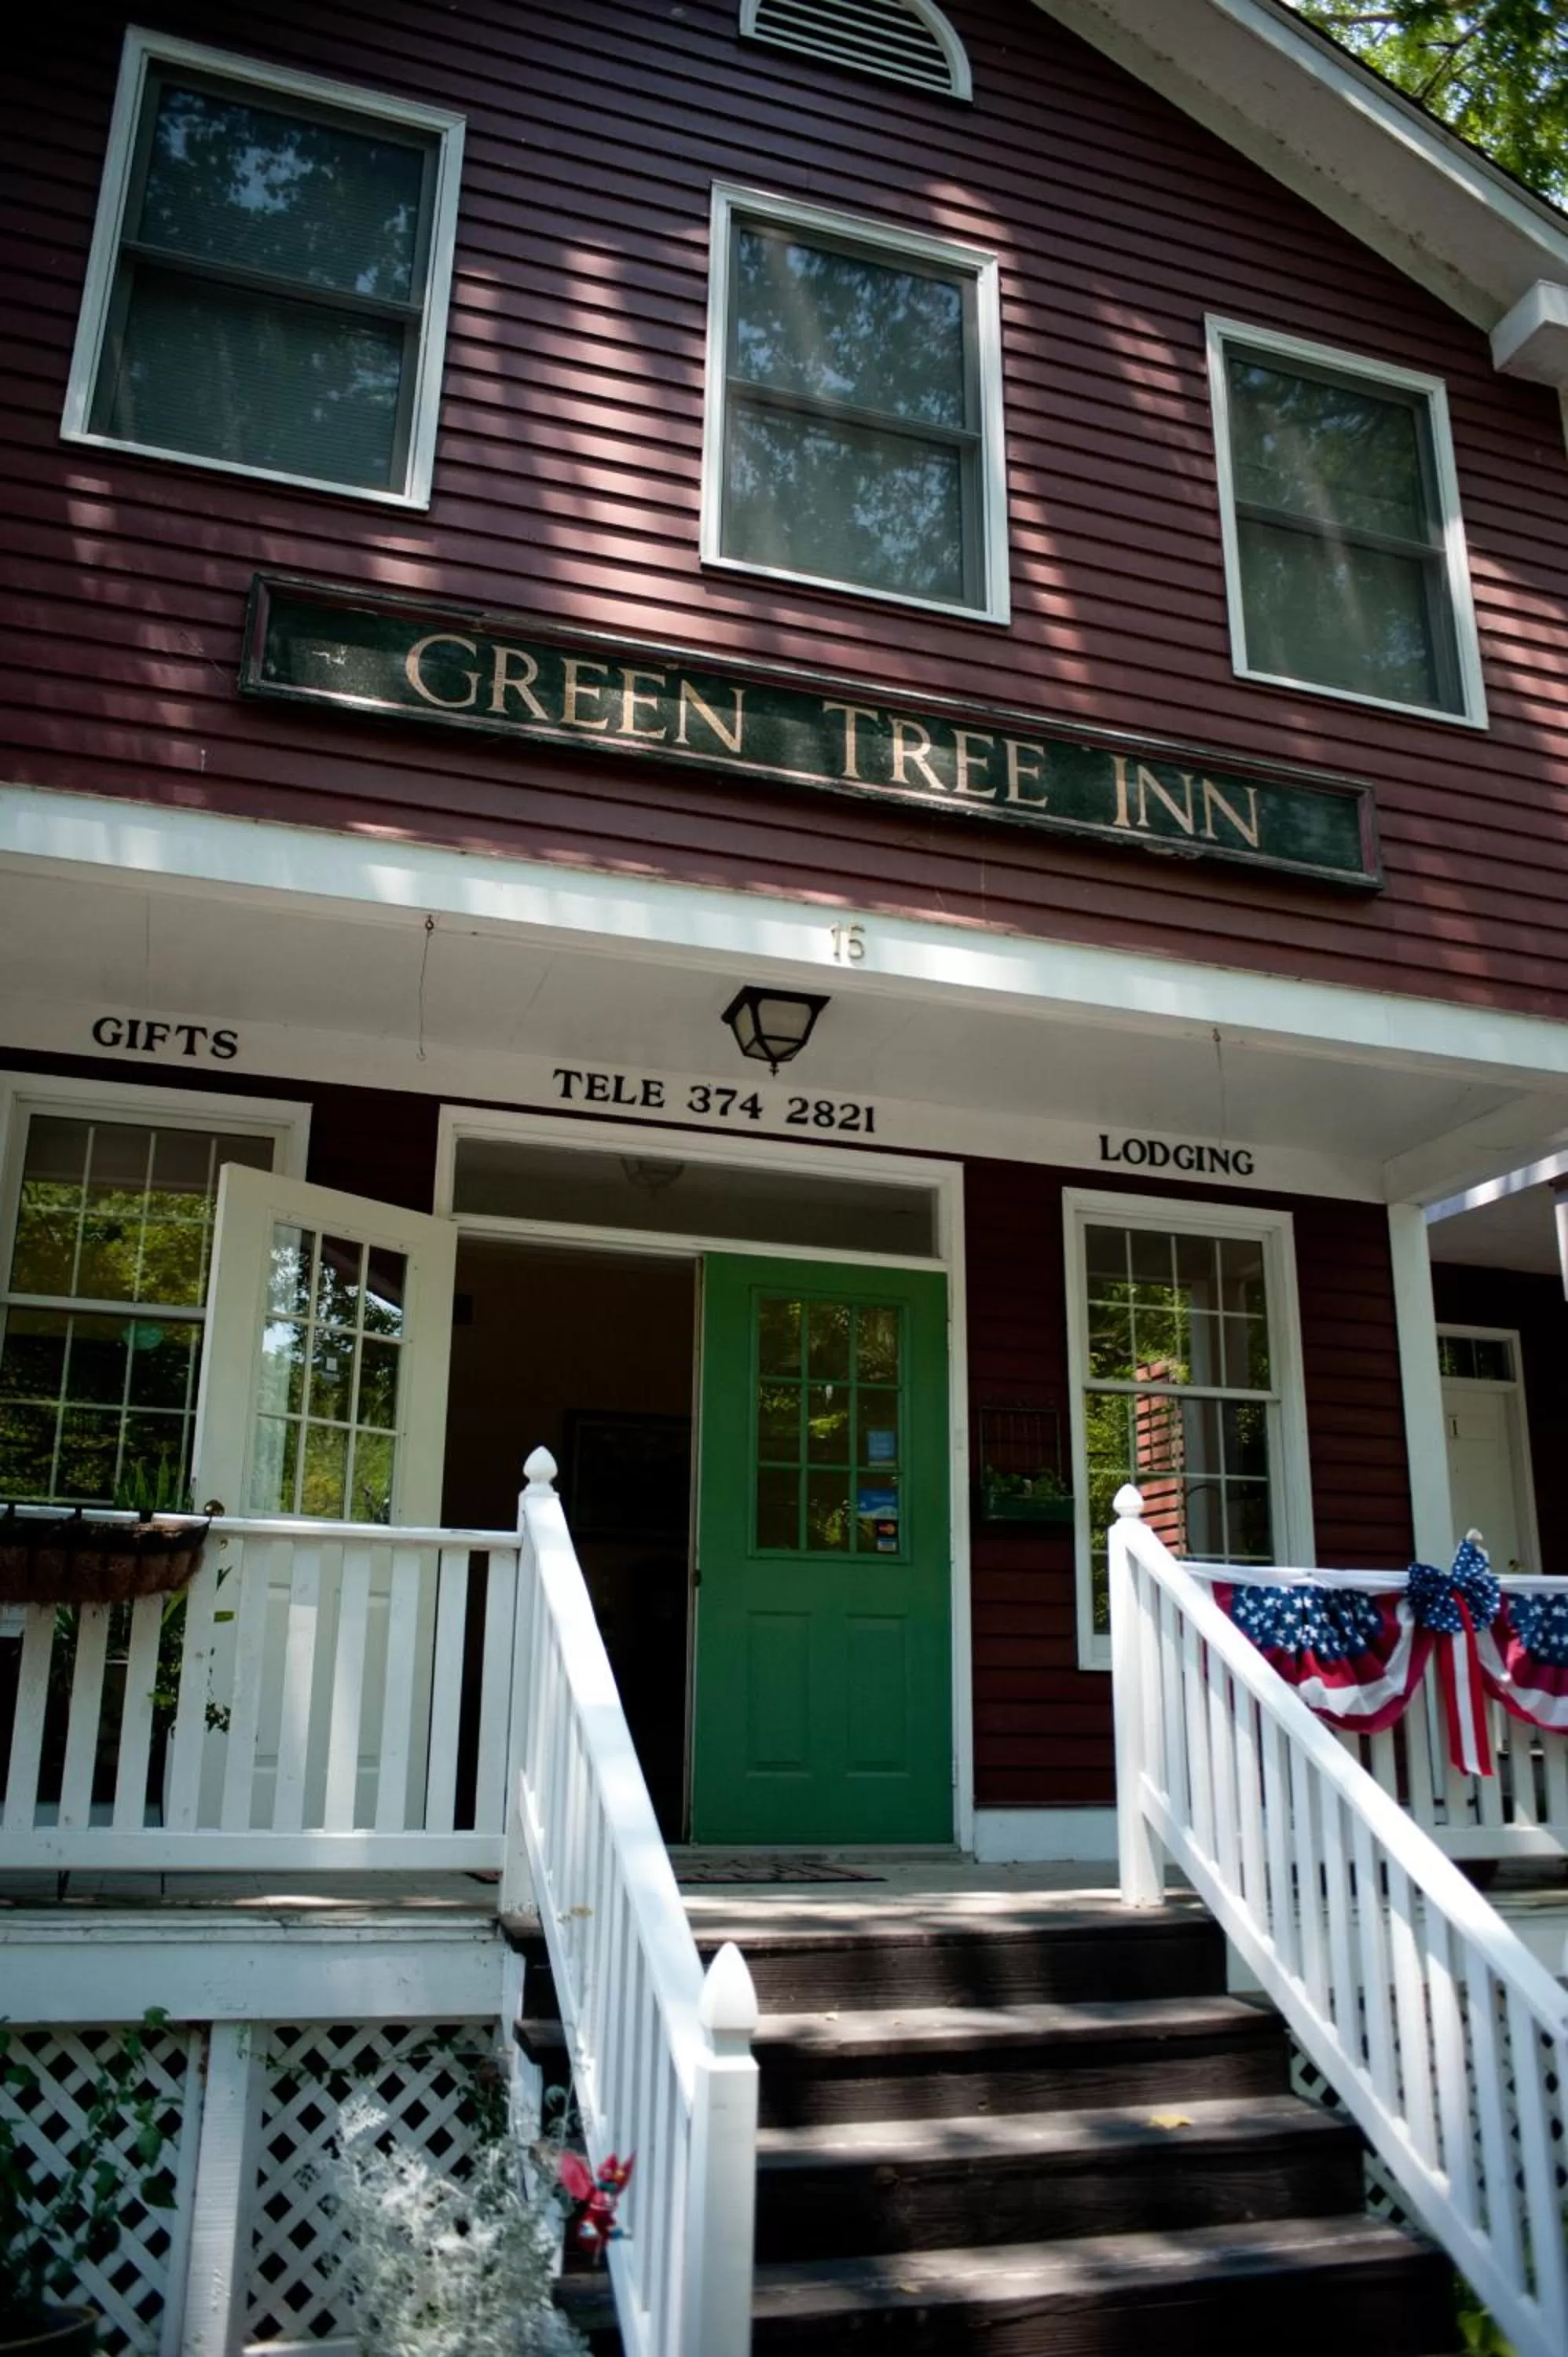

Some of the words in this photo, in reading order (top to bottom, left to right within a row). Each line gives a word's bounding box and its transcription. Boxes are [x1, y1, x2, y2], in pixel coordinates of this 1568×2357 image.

[405, 634, 744, 754] GREEN
[822, 701, 1048, 809] TREE
[1112, 755, 1258, 849] INN
[92, 1016, 239, 1061] GIFTS
[552, 1068, 665, 1109] TELE
[687, 1085, 763, 1120] 374
[786, 1098, 877, 1133] 2821
[1099, 1134, 1255, 1175] LODGING
